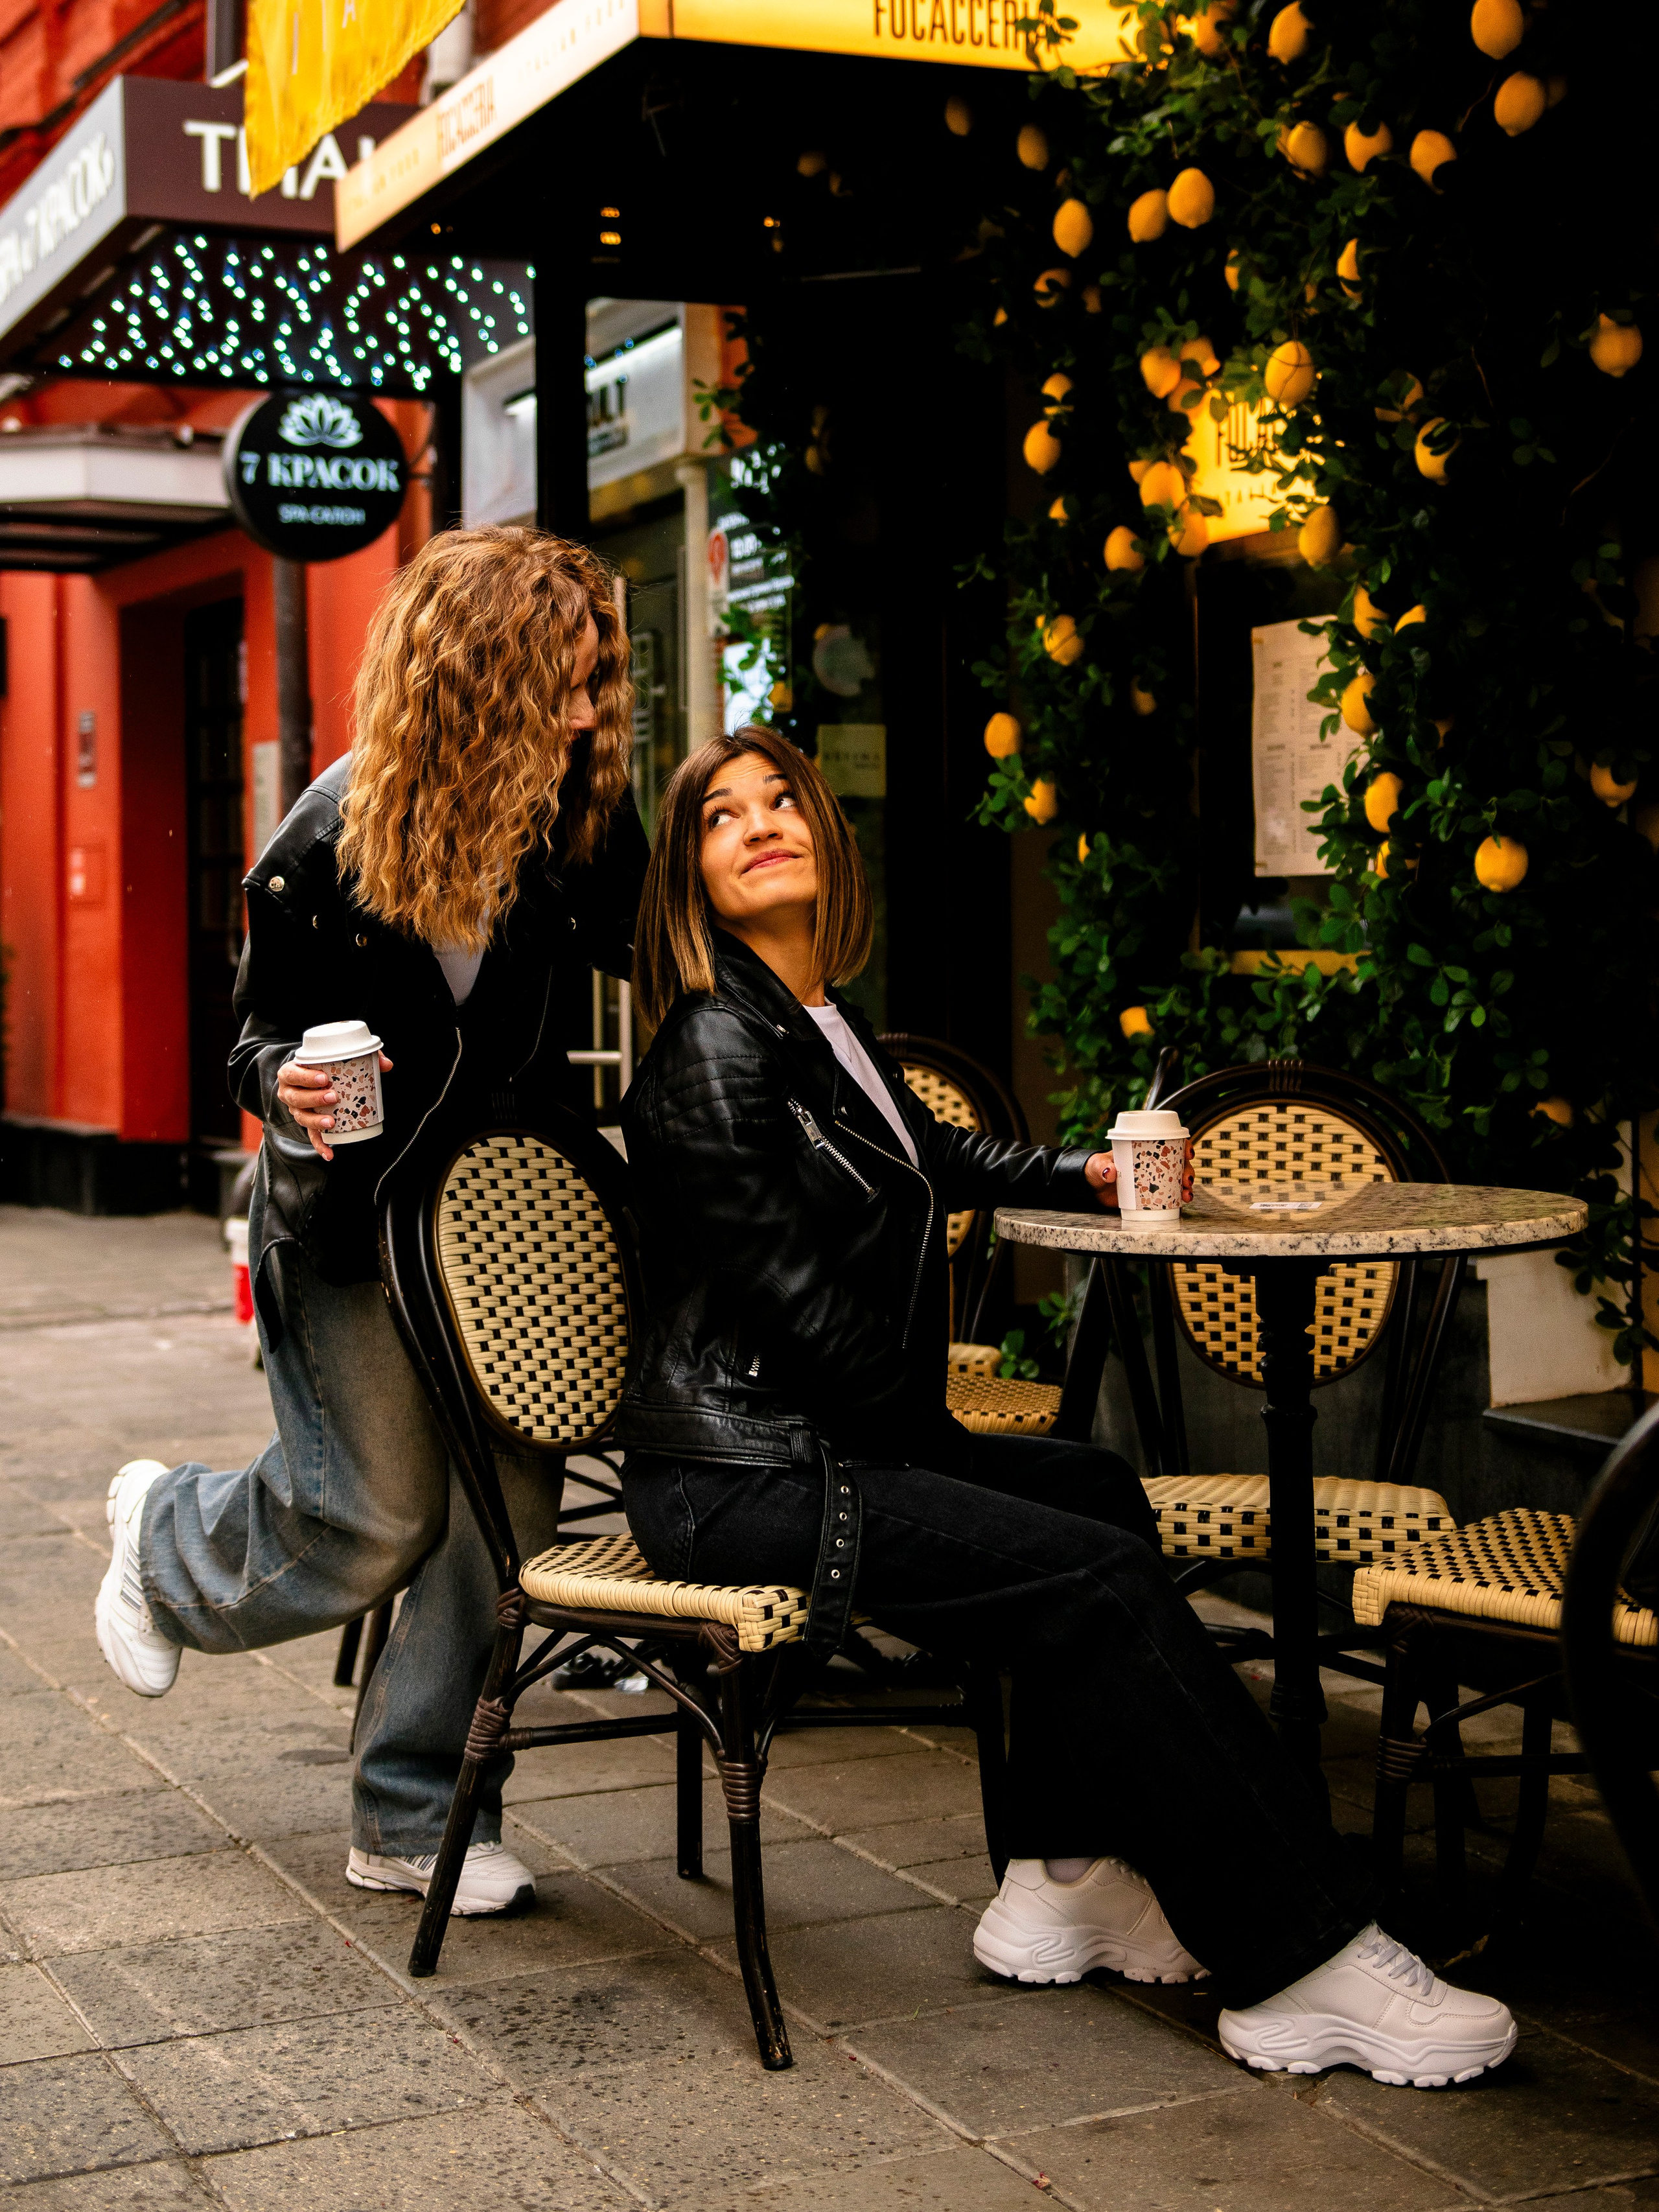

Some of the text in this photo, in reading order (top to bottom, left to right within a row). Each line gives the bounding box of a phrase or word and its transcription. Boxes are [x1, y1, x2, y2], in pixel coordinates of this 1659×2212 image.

[182, 119, 376, 200] TA
[239, 451, 400, 493] 7 КРАСОК
